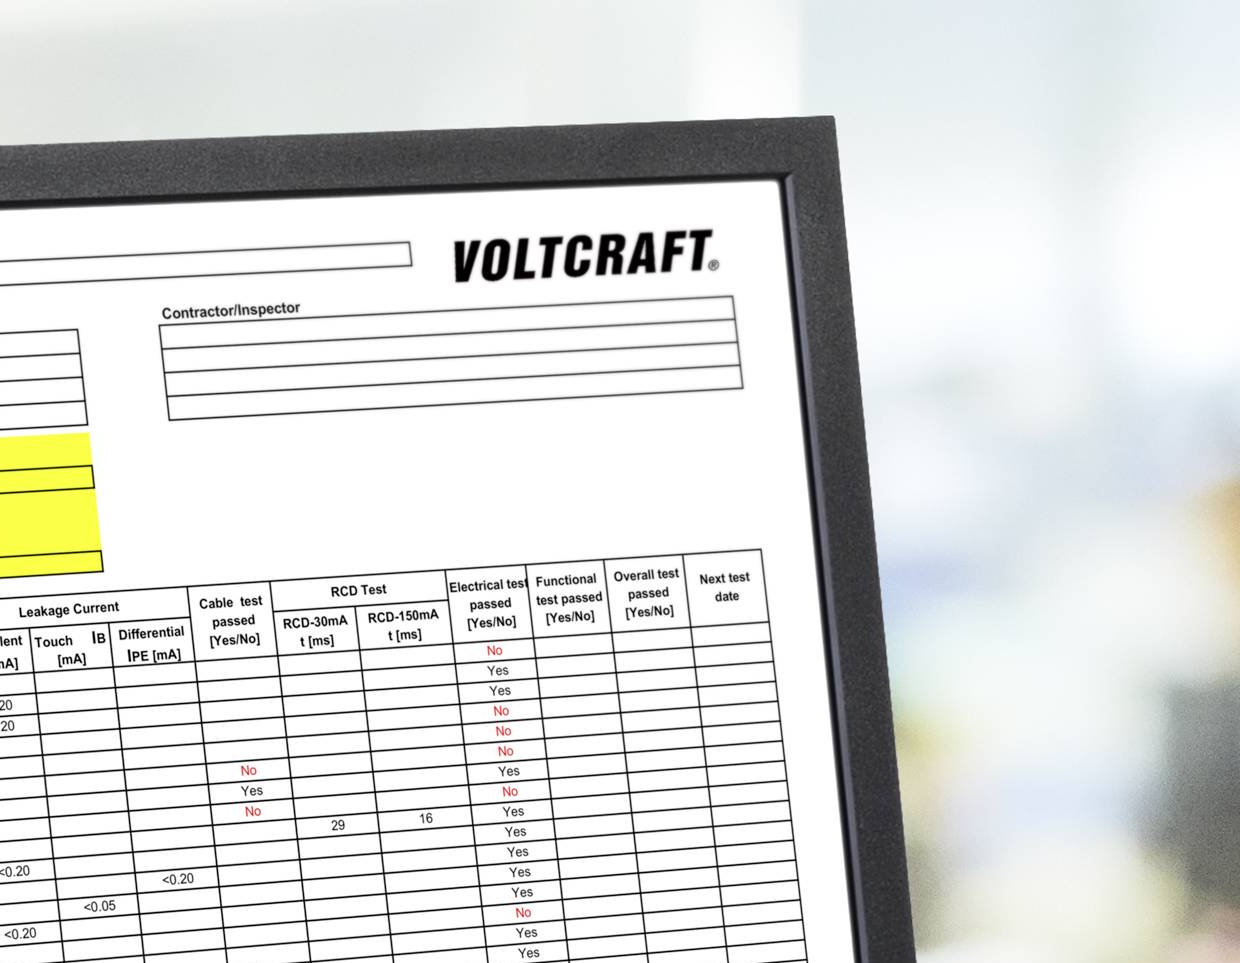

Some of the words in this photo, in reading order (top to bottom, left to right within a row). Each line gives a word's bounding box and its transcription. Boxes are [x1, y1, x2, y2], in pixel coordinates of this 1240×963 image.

[162, 303, 300, 319] Contractor/Inspector
[536, 573, 596, 586] Functional
[614, 570, 654, 581] Overall
[658, 568, 679, 579] test
[700, 574, 725, 584] Next
[729, 573, 750, 582] test
[331, 586, 357, 597] RCD
[361, 585, 387, 595] Test
[450, 579, 503, 592] Electrical
[507, 580, 528, 589] test
[536, 595, 558, 605] test
[562, 591, 602, 606] passed
[629, 587, 669, 601] passed
[715, 592, 739, 601] date
[200, 598, 233, 609] Cable
[240, 596, 262, 606] test
[470, 597, 511, 612] passed
[19, 606, 69, 618] Leakage
[74, 602, 119, 614] Current
[368, 609, 439, 623] RCD-150mA
[626, 605, 674, 620] [Yes/No]
[213, 615, 255, 630] passed
[283, 615, 348, 629] RCD-30mA
[468, 616, 516, 631] [Yes/No]
[546, 610, 594, 626] [Yes/No]
[34, 636, 72, 647] Touch
[92, 631, 105, 644] IB
[119, 626, 184, 640] Differential
[389, 632, 393, 640] t
[396, 629, 422, 643] [ms]
[210, 633, 260, 649] [Yes/No]
[300, 637, 305, 647] t
[309, 634, 334, 649] [ms]
[128, 649, 149, 662] IPE
[153, 645, 181, 662] [mA]
[488, 646, 502, 655] No
[58, 653, 86, 668] [mA]
[488, 666, 508, 675] Yes
[241, 766, 256, 775] No
[241, 786, 263, 796] Yes
[332, 820, 345, 830] 29
[420, 813, 432, 823] 16
[84, 900, 115, 912] <0.05
